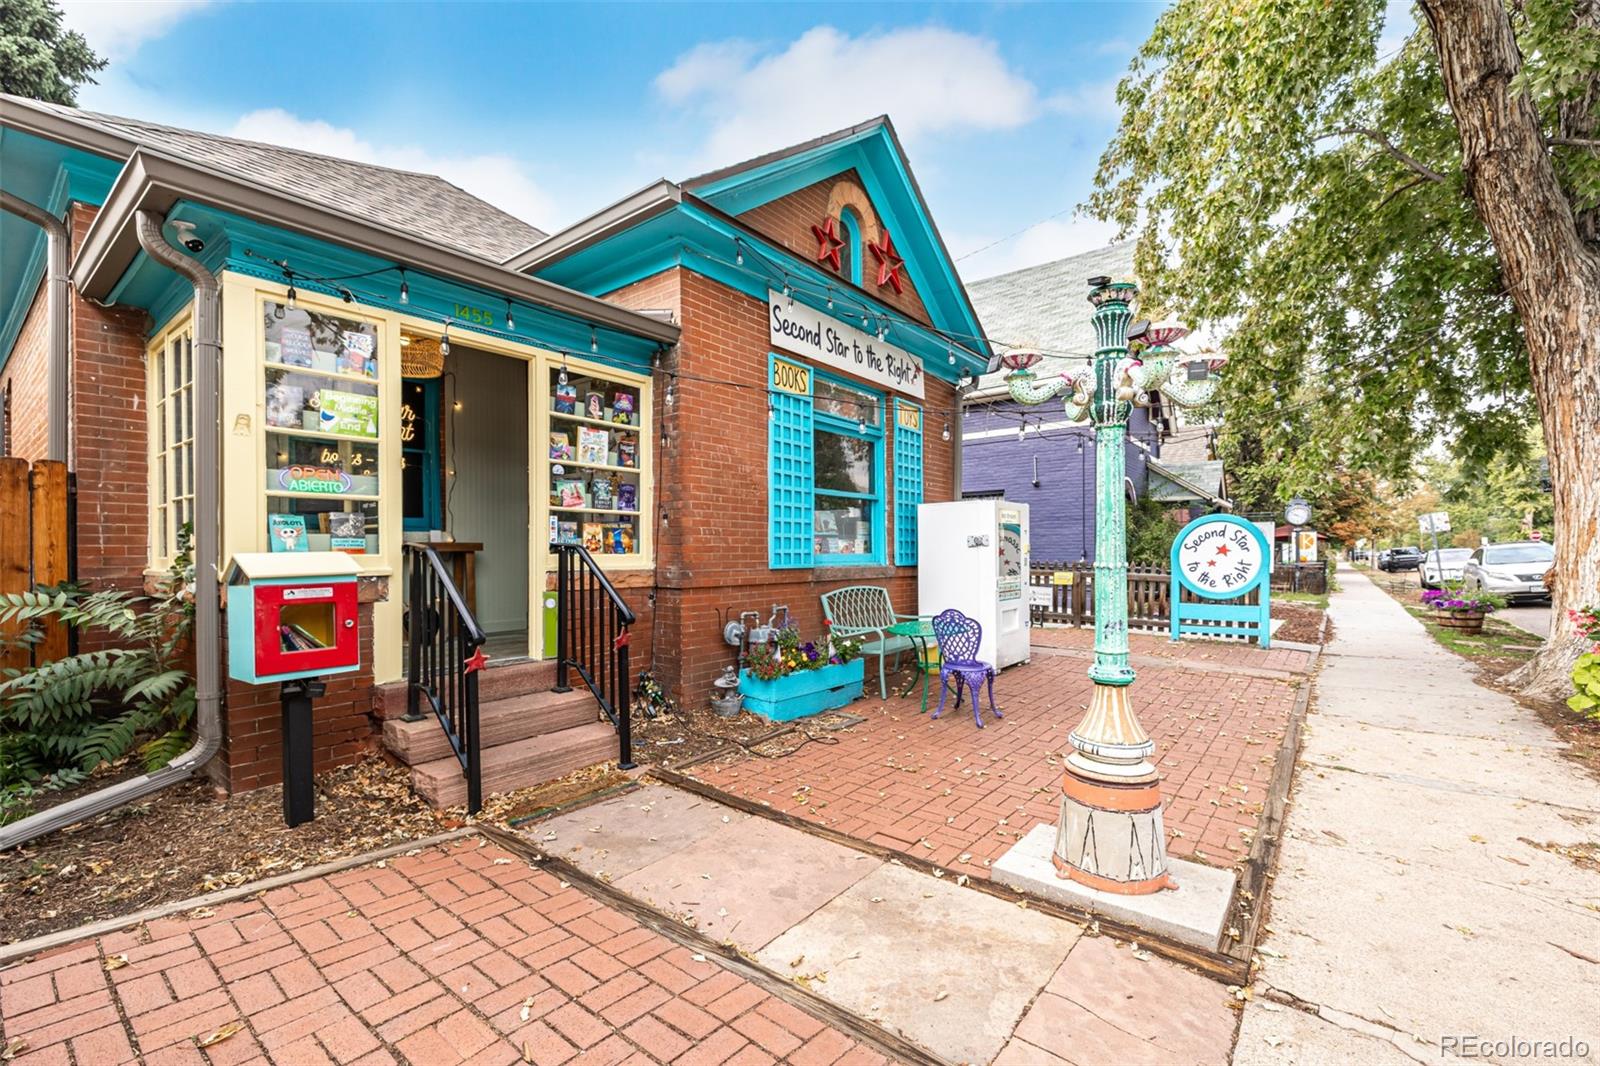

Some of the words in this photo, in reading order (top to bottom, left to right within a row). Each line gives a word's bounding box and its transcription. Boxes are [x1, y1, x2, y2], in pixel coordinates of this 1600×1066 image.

[454, 303, 493, 326] 1455
[772, 304, 822, 350] Second
[826, 327, 850, 359] Star
[853, 338, 863, 364] to
[866, 345, 884, 372] the
[885, 354, 912, 385] Right
[773, 362, 807, 393] BOOKS
[898, 404, 918, 428] TOYS
[288, 479, 345, 493] ABIERTO
[290, 466, 341, 481] OPEN
[1184, 525, 1227, 552] Second
[1229, 529, 1250, 552] Star
[1187, 560, 1201, 573] to
[1197, 571, 1217, 588] the
[1222, 559, 1253, 588] Right
